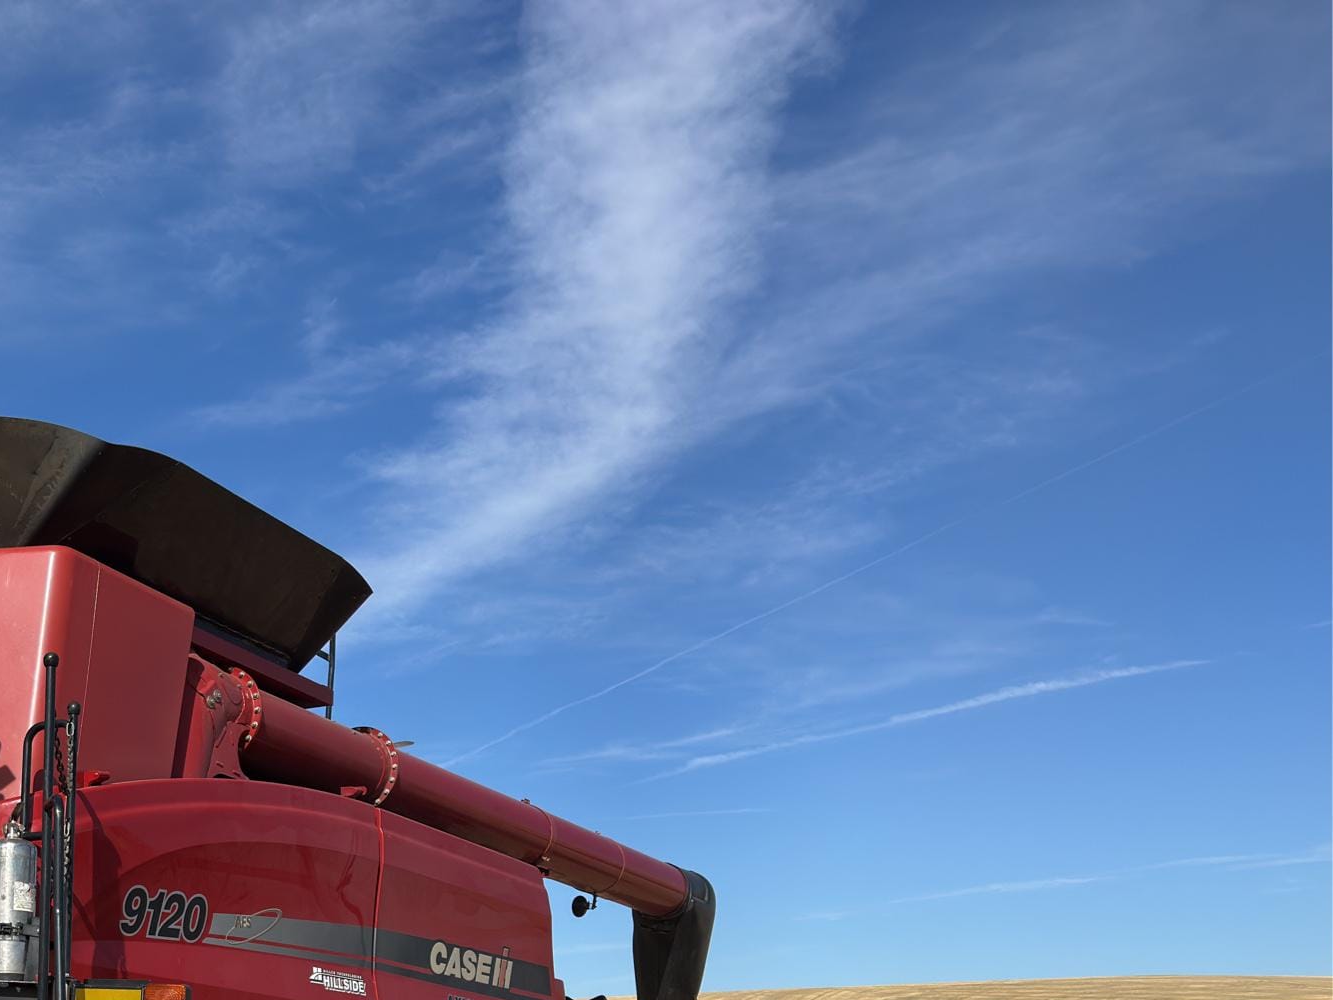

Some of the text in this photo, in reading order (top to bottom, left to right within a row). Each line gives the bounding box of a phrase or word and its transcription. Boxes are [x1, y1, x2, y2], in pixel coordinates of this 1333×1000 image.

[119, 885, 208, 943] 9120
[234, 915, 252, 929] AFS
[430, 941, 493, 985] CASE
[323, 975, 366, 994] HILLSIDE
